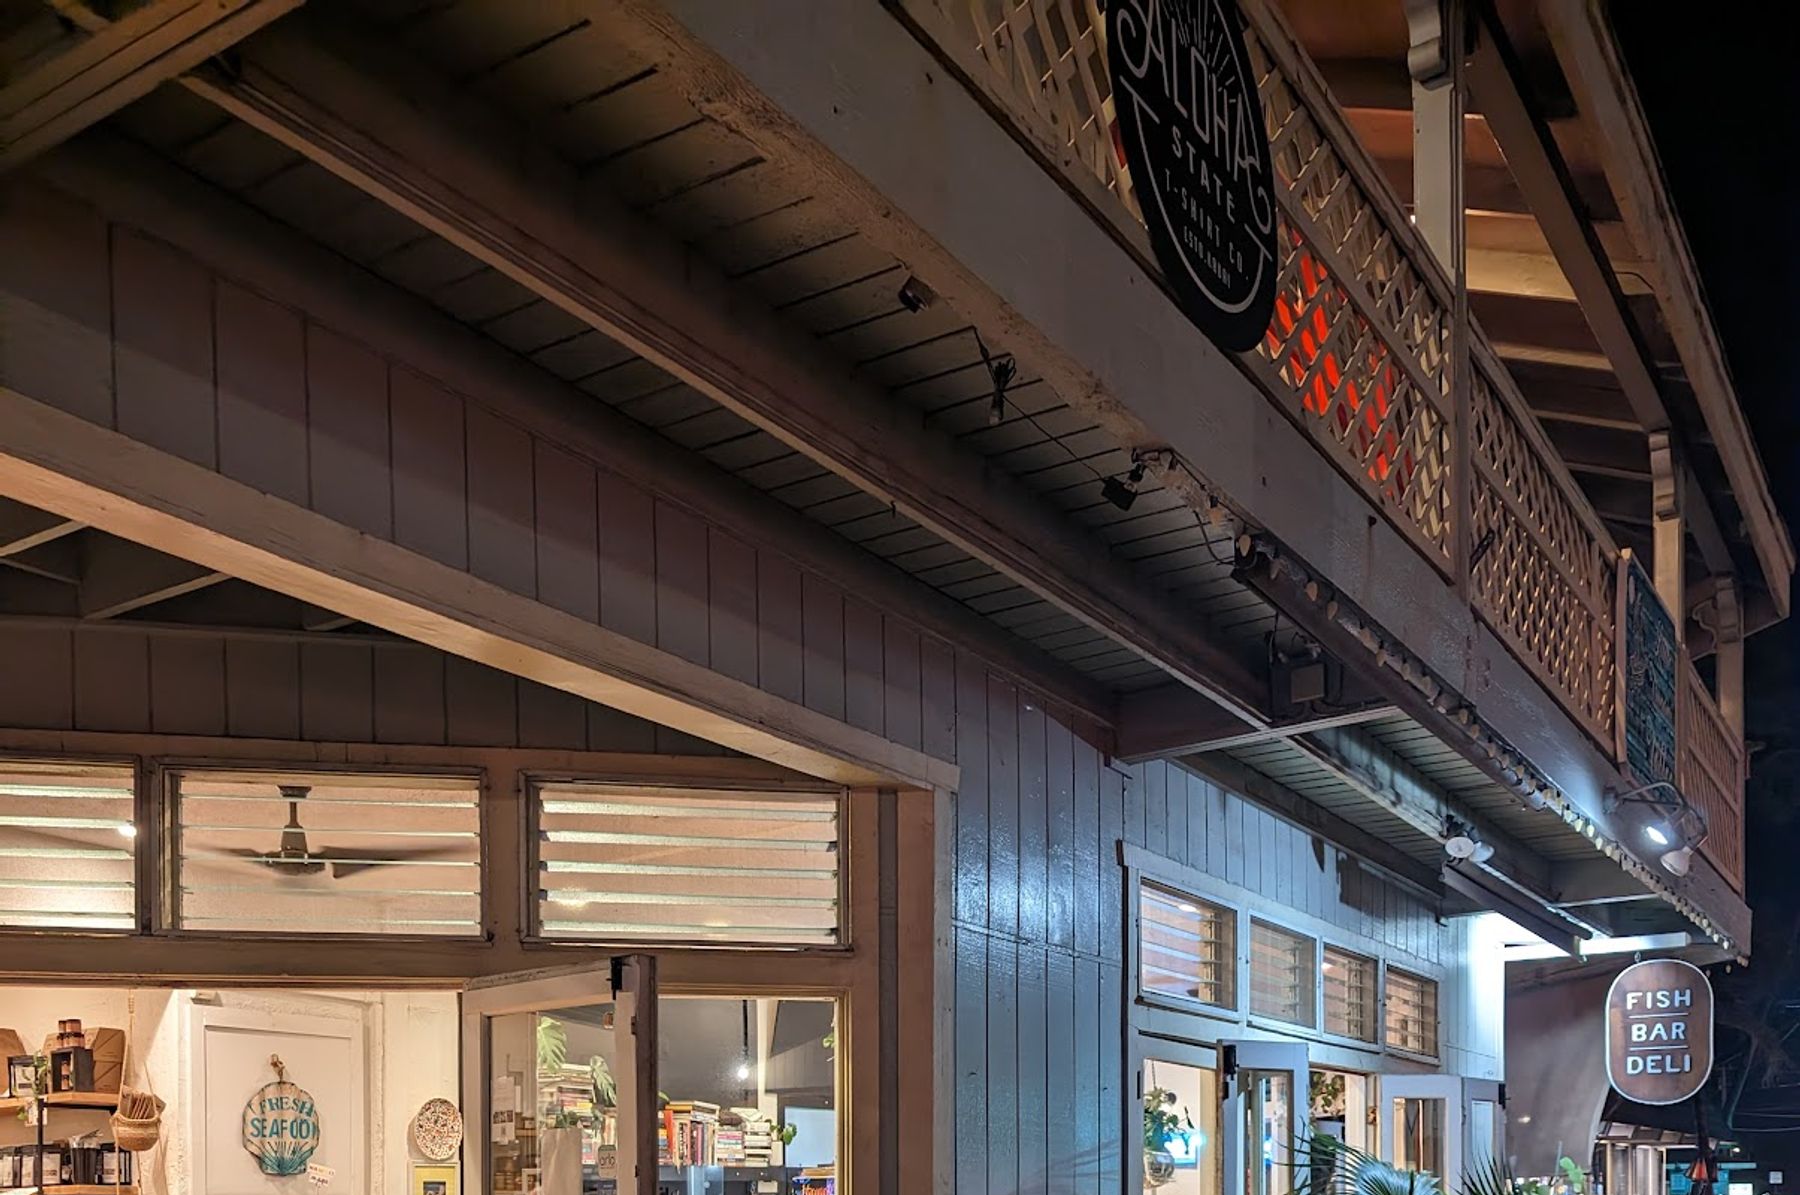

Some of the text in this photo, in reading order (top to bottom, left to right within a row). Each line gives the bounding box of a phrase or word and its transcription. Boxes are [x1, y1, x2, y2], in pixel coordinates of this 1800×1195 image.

[1117, 0, 1271, 234] ALOHA
[1172, 125, 1235, 224] STATE
[1626, 989, 1691, 1010] FISH
[1631, 1022, 1685, 1042] BAR
[1626, 1054, 1691, 1075] DELI
[259, 1096, 315, 1118] FRESH
